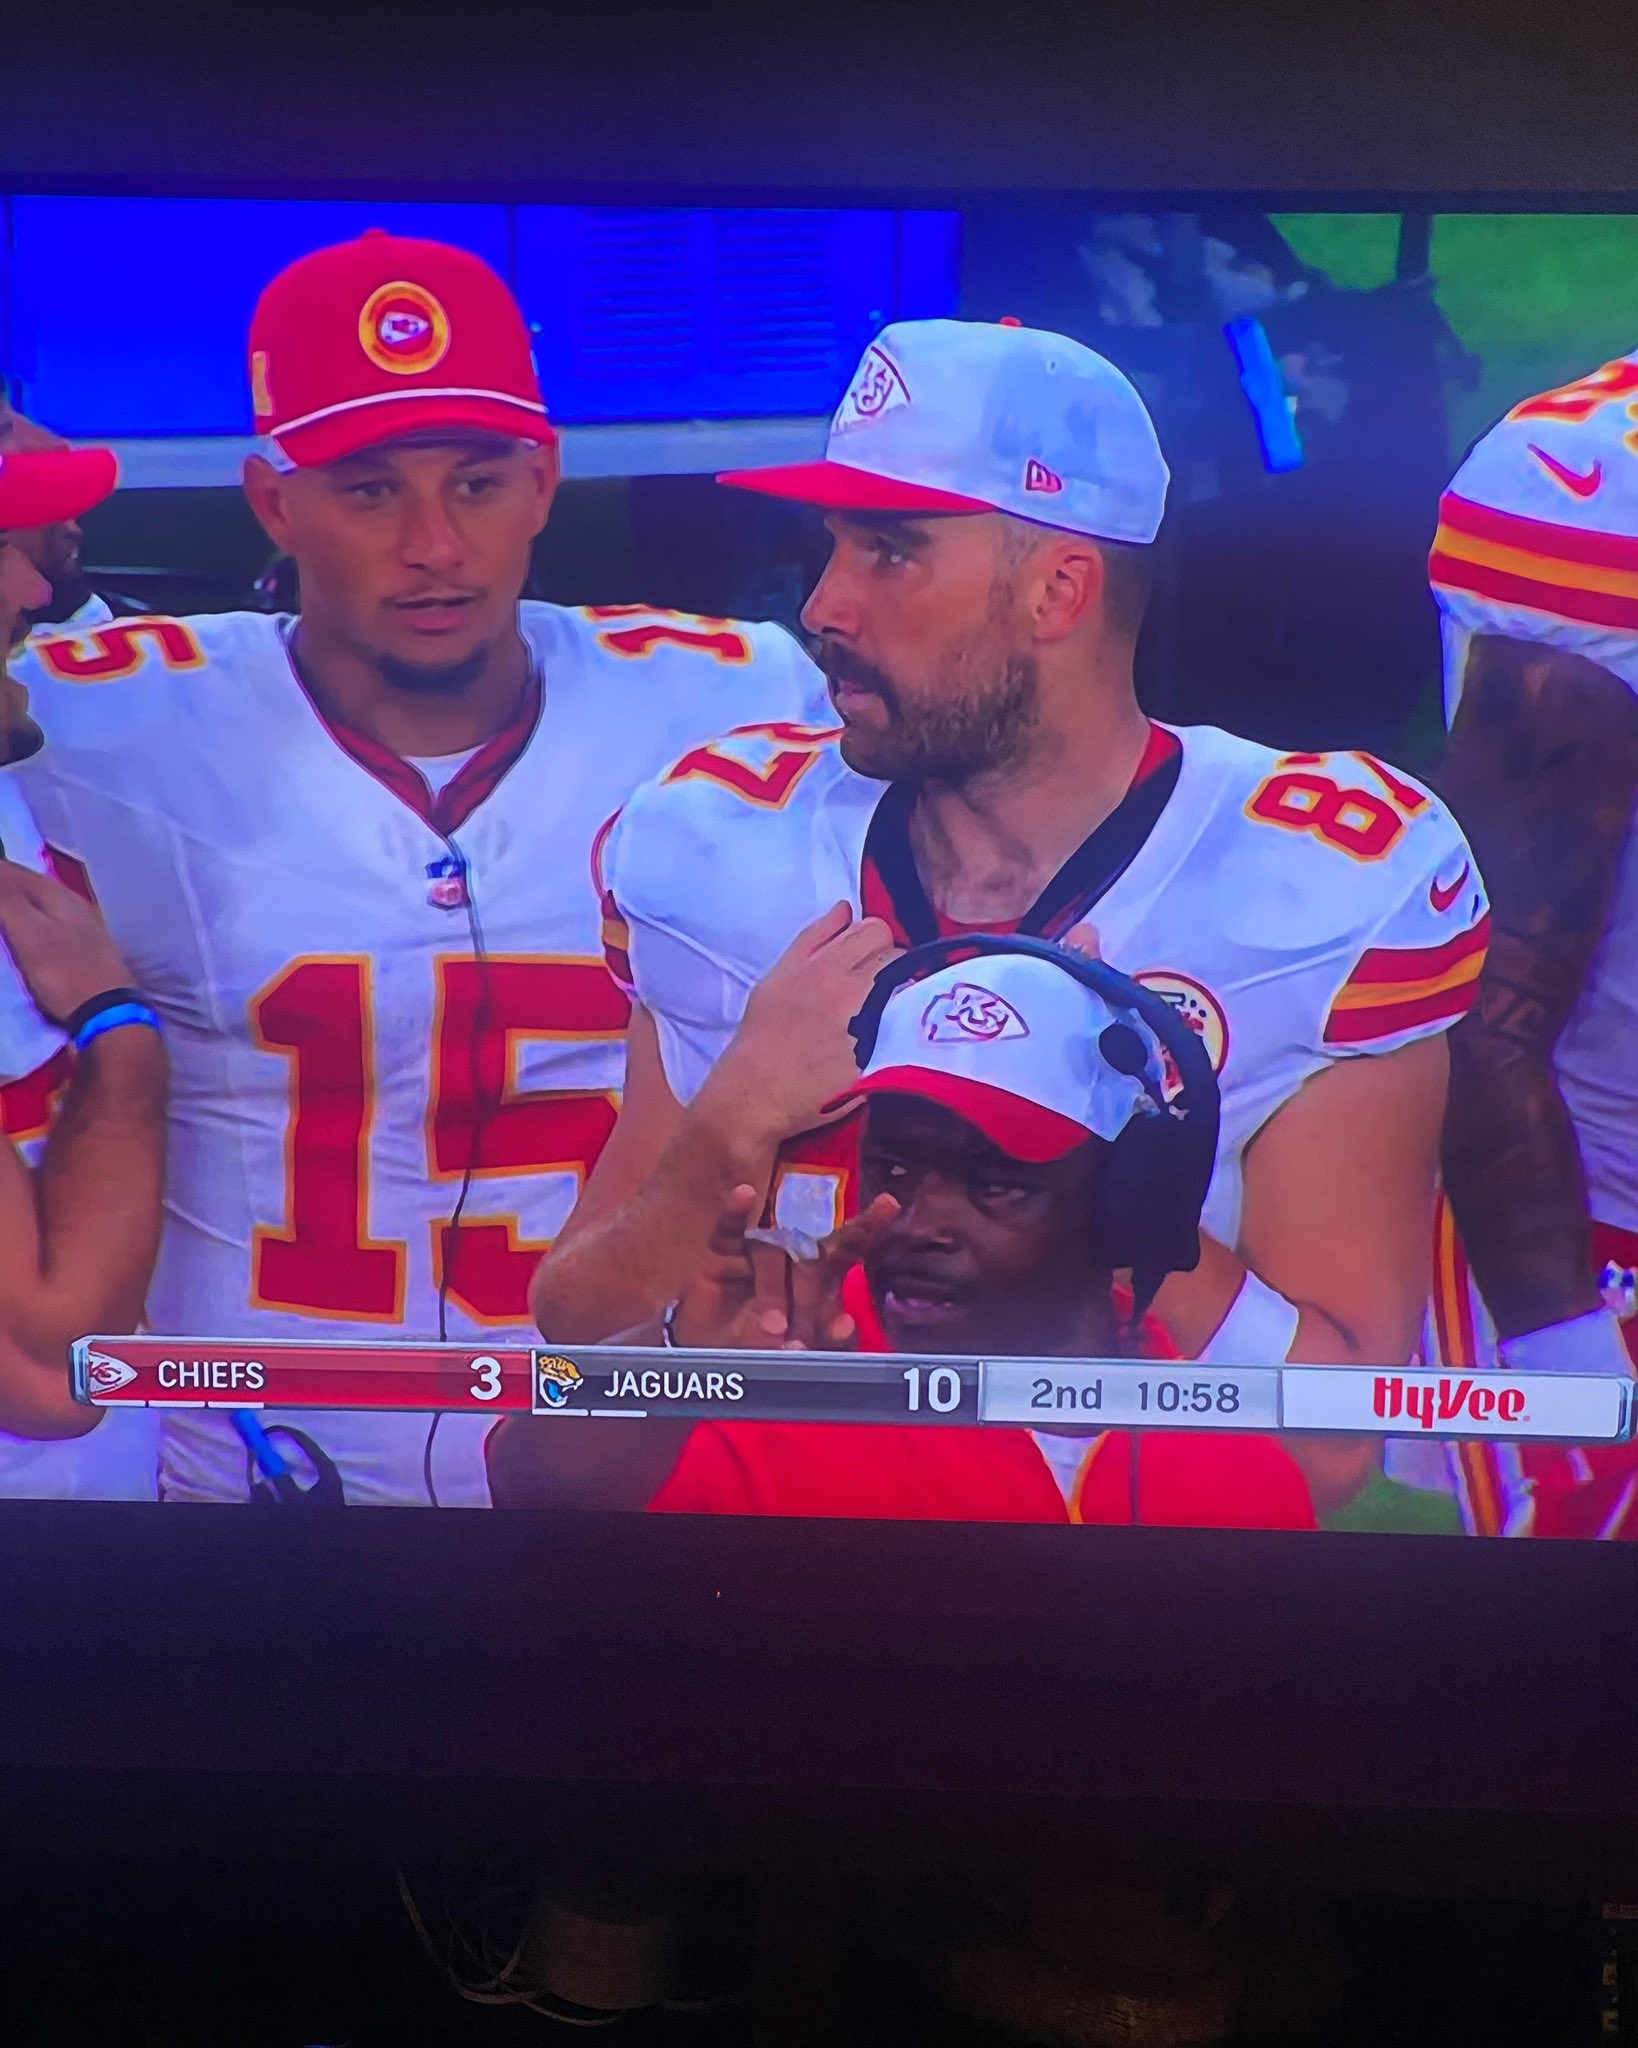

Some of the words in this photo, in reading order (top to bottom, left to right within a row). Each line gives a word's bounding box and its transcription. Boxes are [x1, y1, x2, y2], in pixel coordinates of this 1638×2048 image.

[250, 953, 632, 1327] 15
[157, 1360, 264, 1390] CHIEFS
[469, 1357, 501, 1401] 3
[604, 1370, 744, 1401] JAGUARS
[903, 1367, 961, 1413] 10
[1030, 1378, 1102, 1408] 2nd
[1137, 1381, 1240, 1413] 10:58
